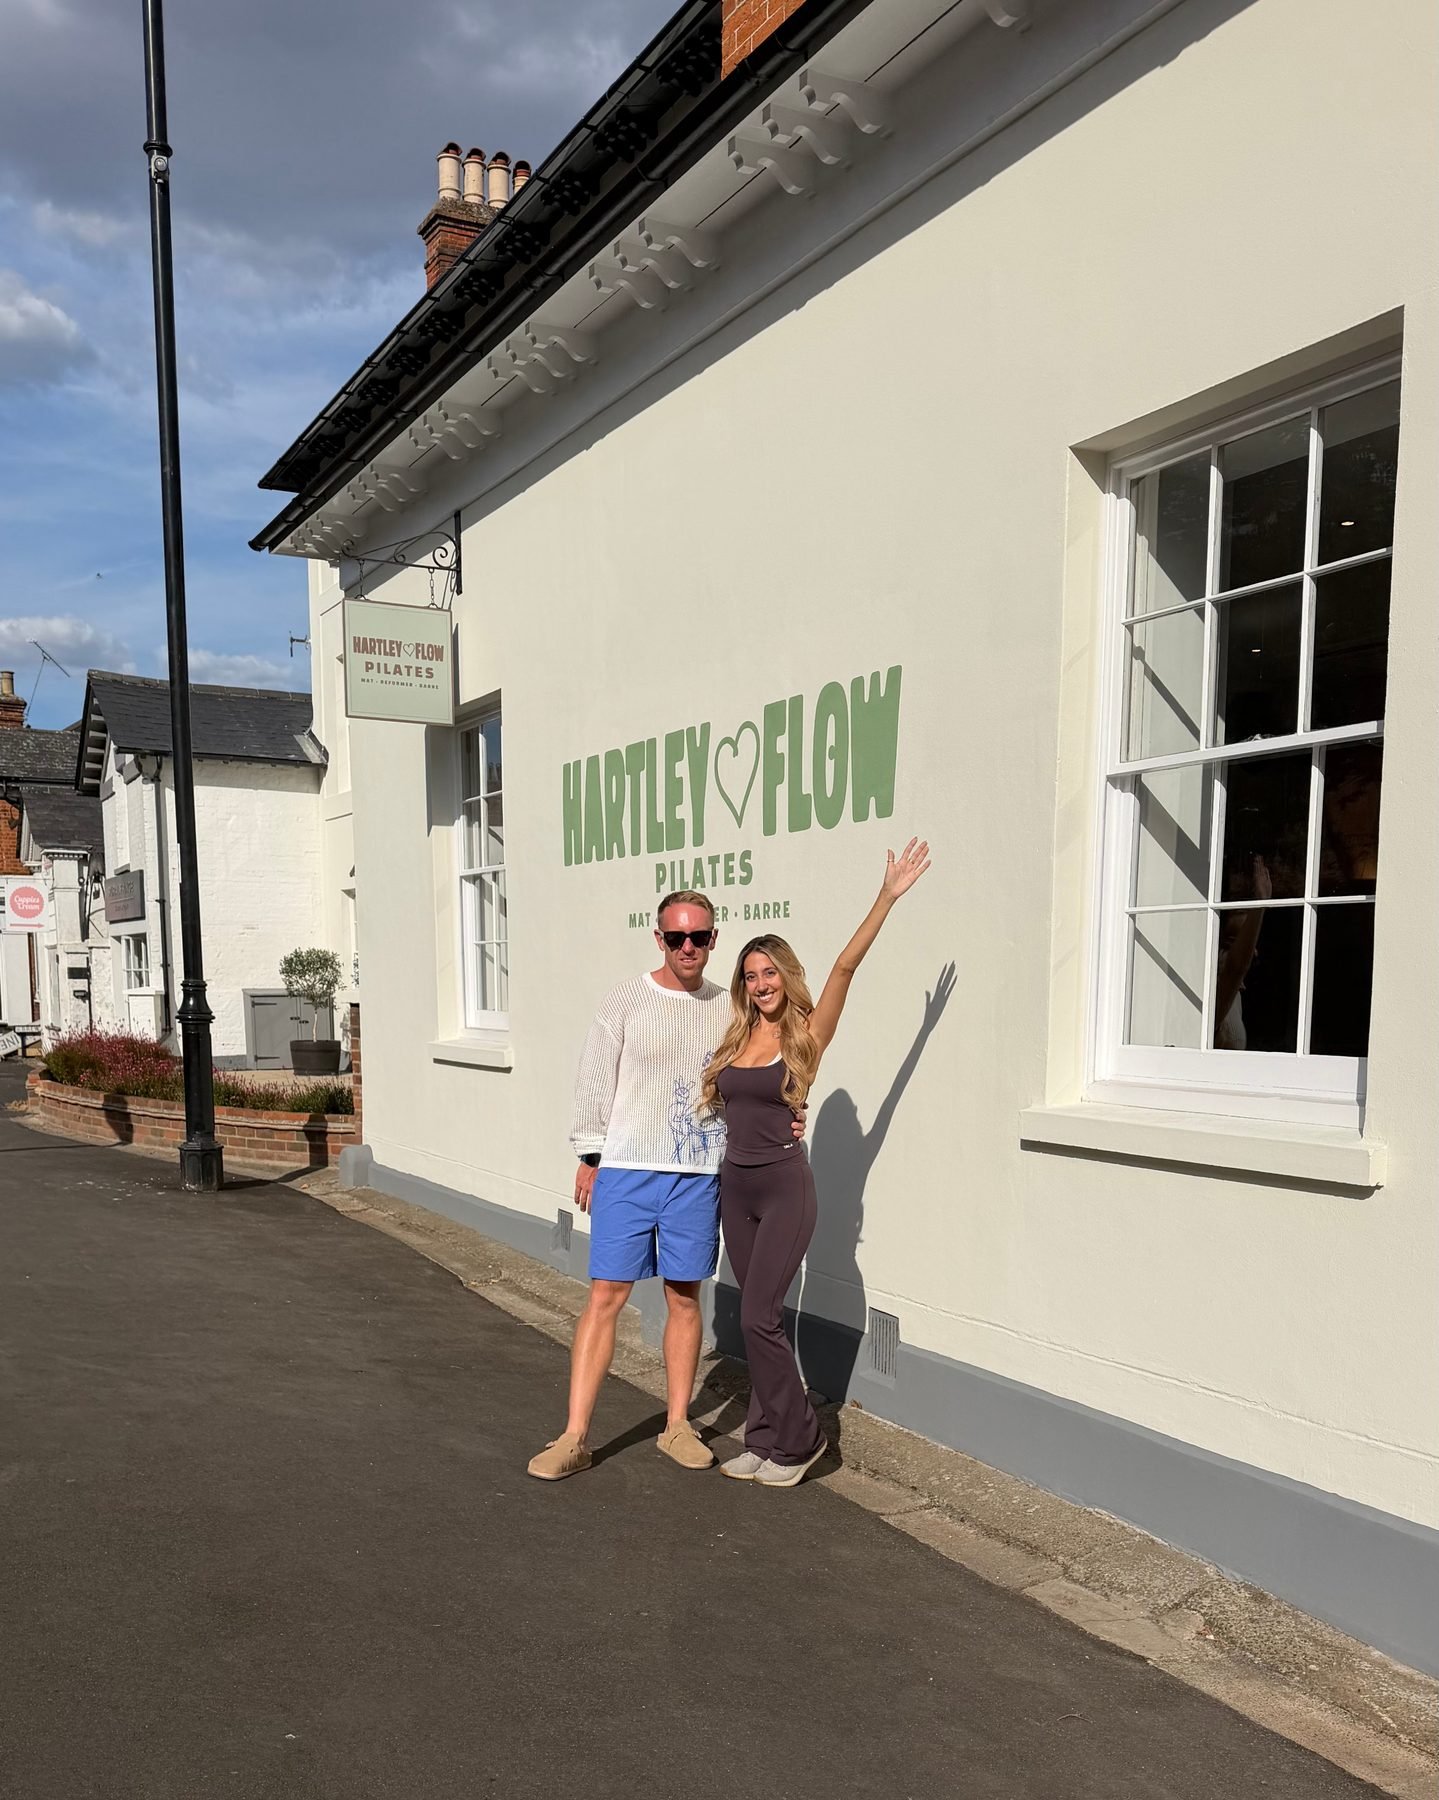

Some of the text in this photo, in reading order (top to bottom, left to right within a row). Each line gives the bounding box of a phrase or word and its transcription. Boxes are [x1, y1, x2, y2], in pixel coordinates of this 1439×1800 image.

[353, 636, 444, 662] HARTLEY FLOW
[365, 661, 434, 679] PILATES
[562, 664, 902, 867] HARTLEY FLOW
[655, 850, 754, 893] PILATES
[628, 912, 651, 928] MAT
[743, 901, 791, 921] BARRE
